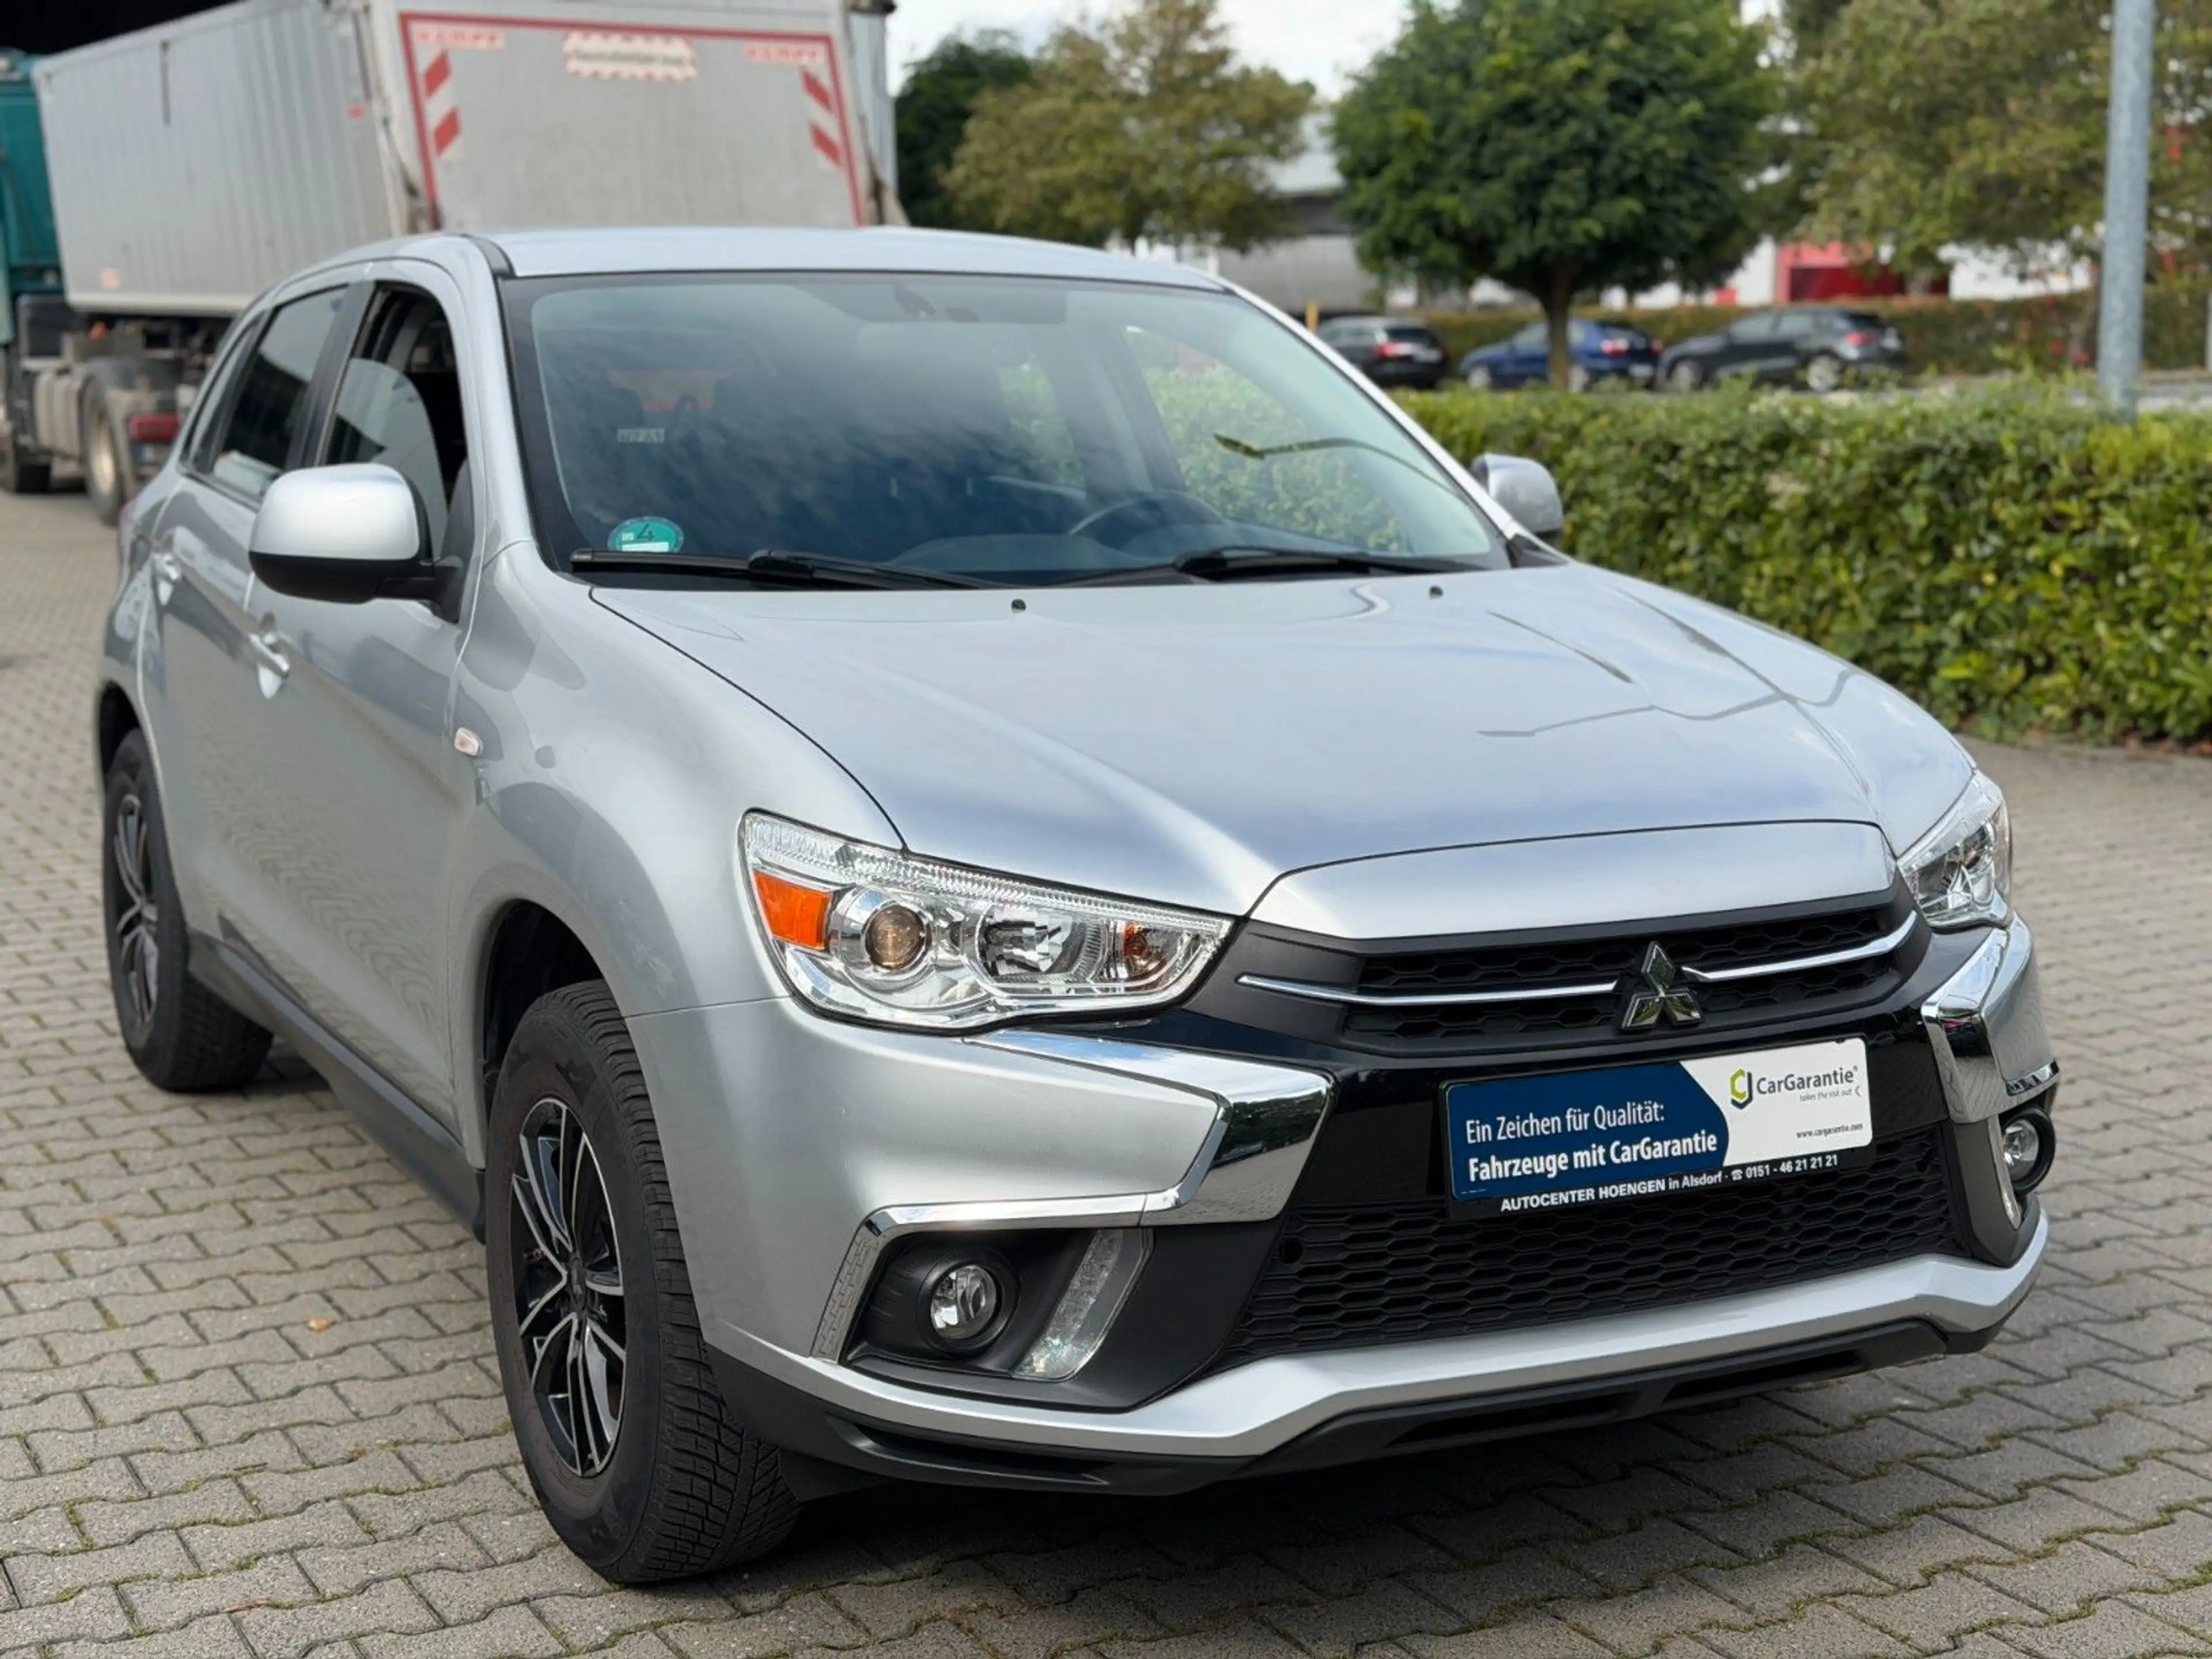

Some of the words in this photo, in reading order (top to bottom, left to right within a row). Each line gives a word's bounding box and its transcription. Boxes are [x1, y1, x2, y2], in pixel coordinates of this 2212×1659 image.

[1466, 1119, 1493, 1144] Ein
[1496, 1112, 1562, 1141] Zeichen
[1565, 1107, 1590, 1132] für
[1593, 1100, 1665, 1131] Qualität:
[1468, 1152, 1569, 1182] Fahrzeuge
[1573, 1143, 1607, 1169] mit
[1609, 1128, 1718, 1164] CarGarantie
[1500, 1187, 1595, 1211] AUTOCENTER
[1599, 1178, 1666, 1199] HOENGEN
[1668, 1177, 1680, 1190] in
[1681, 1170, 1723, 1188] Alsdorf
[1745, 1164, 1771, 1179] 0151
[1779, 1160, 1794, 1173] 46
[1794, 1158, 1808, 1172] 21
[1810, 1156, 1823, 1169] 21
[1825, 1153, 1838, 1167] 21
